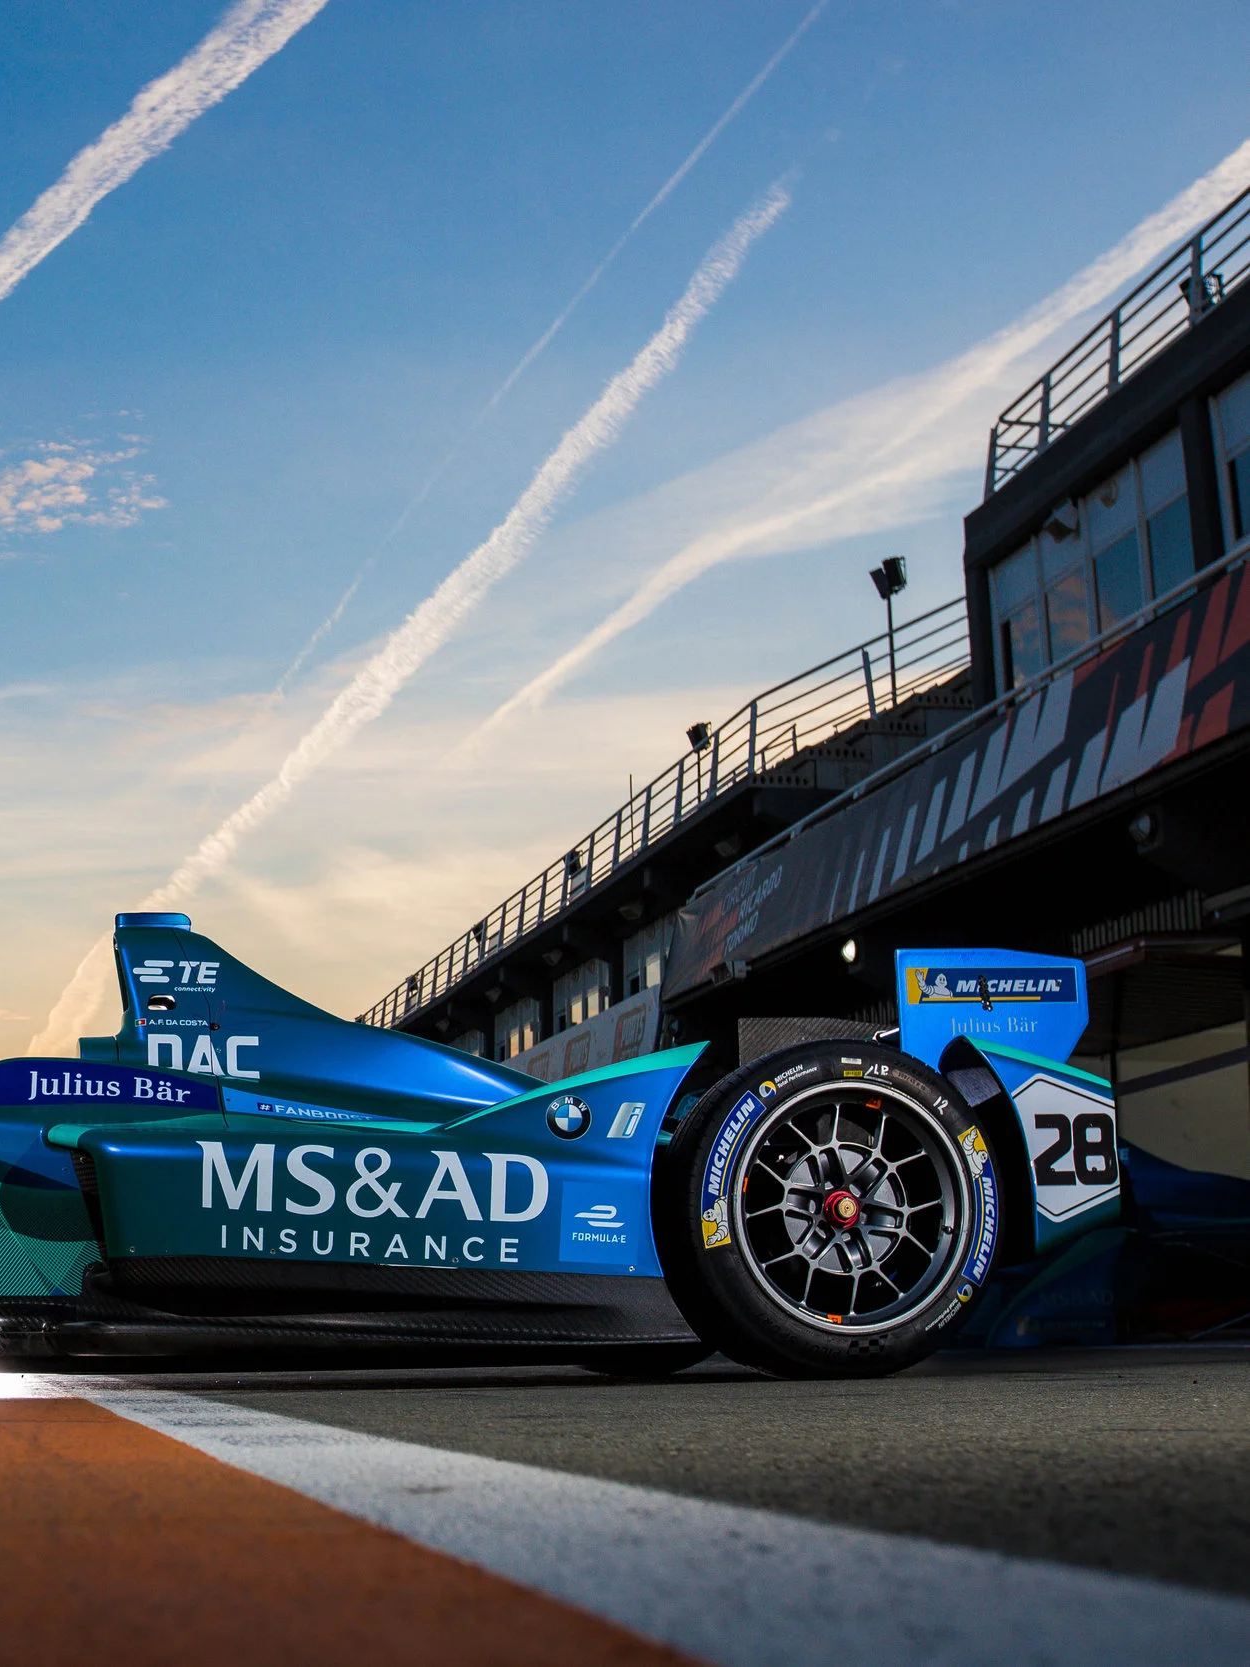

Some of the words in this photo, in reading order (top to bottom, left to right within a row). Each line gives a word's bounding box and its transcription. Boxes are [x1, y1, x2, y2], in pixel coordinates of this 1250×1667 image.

[738, 865, 783, 922] RICARDO
[178, 960, 220, 984] TE
[179, 1019, 209, 1027] COSTA
[951, 1017, 1001, 1037] Julius
[1007, 1016, 1038, 1033] Bär
[28, 1071, 121, 1101] Julius
[133, 1076, 191, 1103] Bär
[774, 1064, 803, 1084] MICHELIN
[777, 1078, 789, 1089] Total
[789, 1066, 818, 1082] Performance
[551, 1096, 588, 1112] BMW
[932, 1095, 949, 1116] 12
[708, 1098, 756, 1196] MICHELIN
[1033, 1113, 1119, 1186] 28
[195, 1140, 549, 1223] MS&AD
[972, 1176, 996, 1280] MICHELIN
[221, 1224, 519, 1263] INSURANCE
